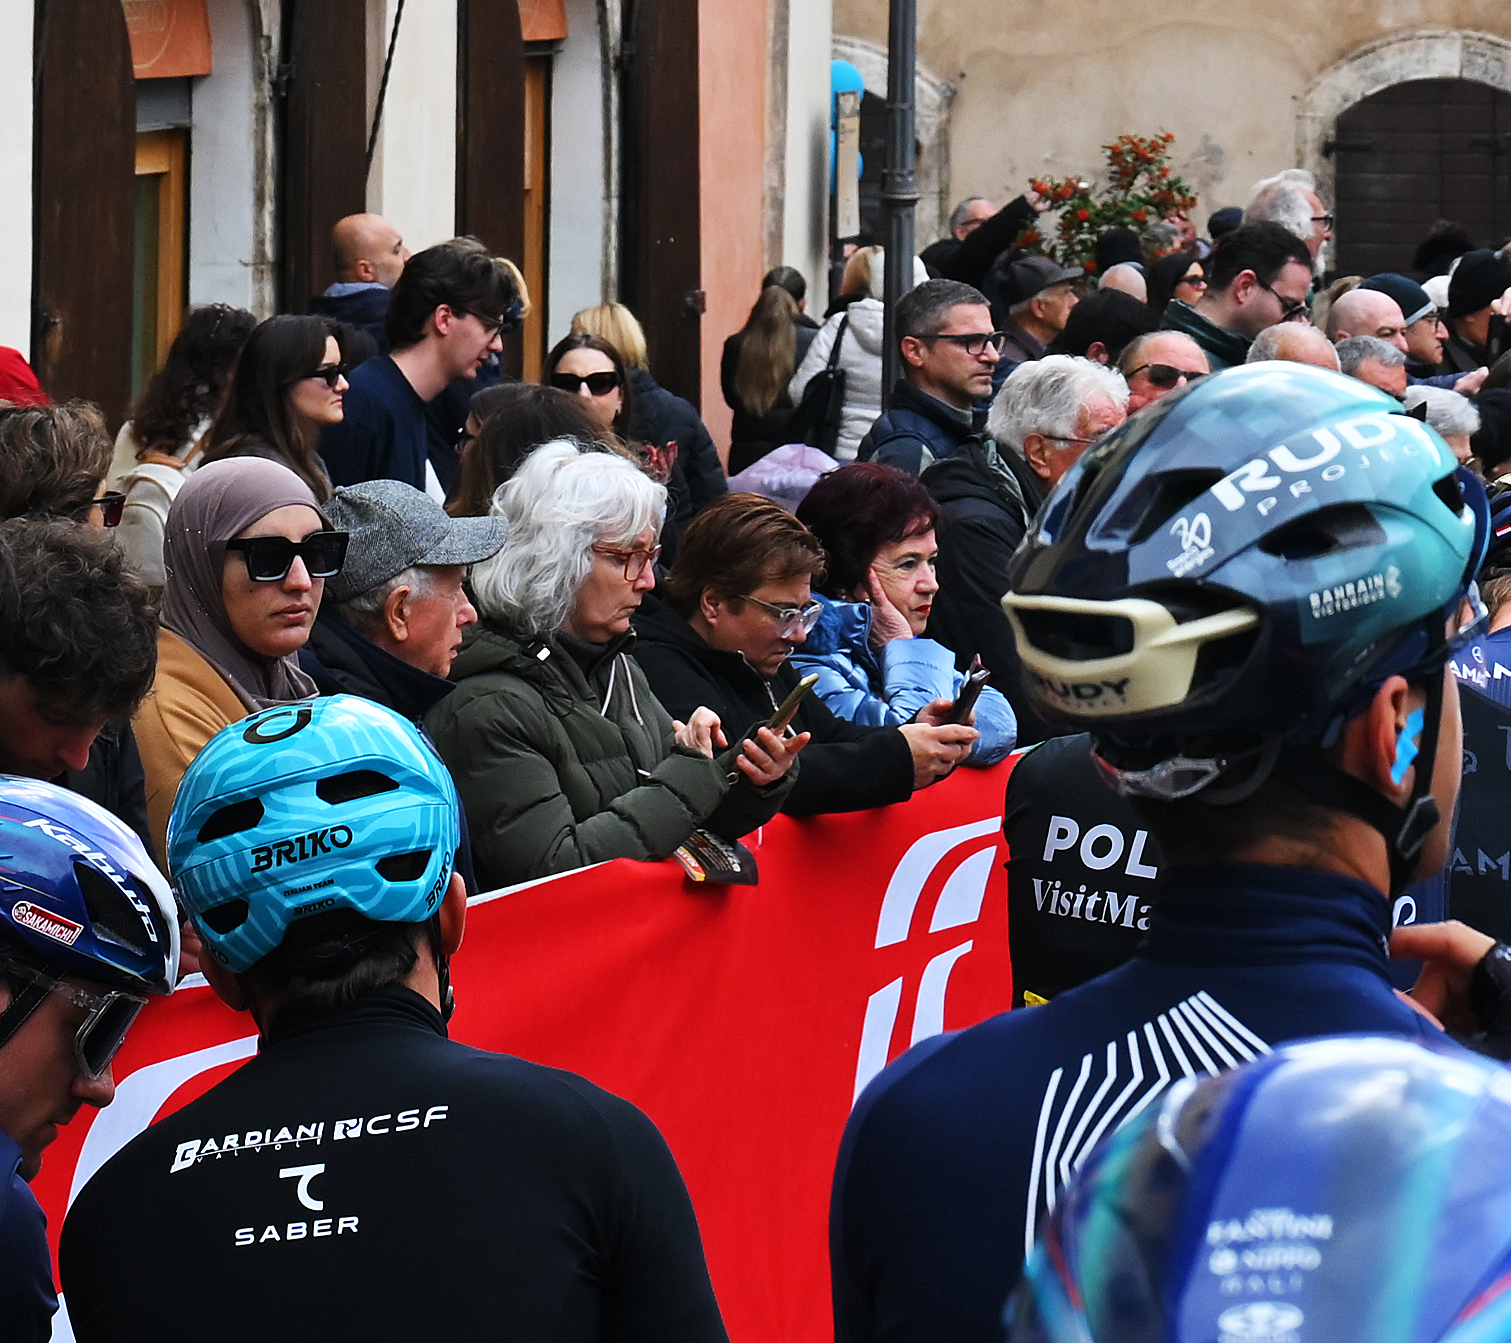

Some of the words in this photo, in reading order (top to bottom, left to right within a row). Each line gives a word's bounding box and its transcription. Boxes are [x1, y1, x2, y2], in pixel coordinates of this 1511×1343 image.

[1309, 573, 1385, 606] BAHRAIN
[250, 824, 353, 874] BRIKO
[23, 818, 159, 943] Kabuto
[283, 883, 313, 897] ITALIAN
[314, 878, 335, 893] TEAM
[425, 851, 451, 912] BRIKO
[293, 897, 335, 916] BRIKO
[22, 910, 81, 946] SAKAMICHI!
[170, 1121, 324, 1174] BARDIANI
[366, 1105, 449, 1135] CSF
[234, 1216, 359, 1246] SABER
